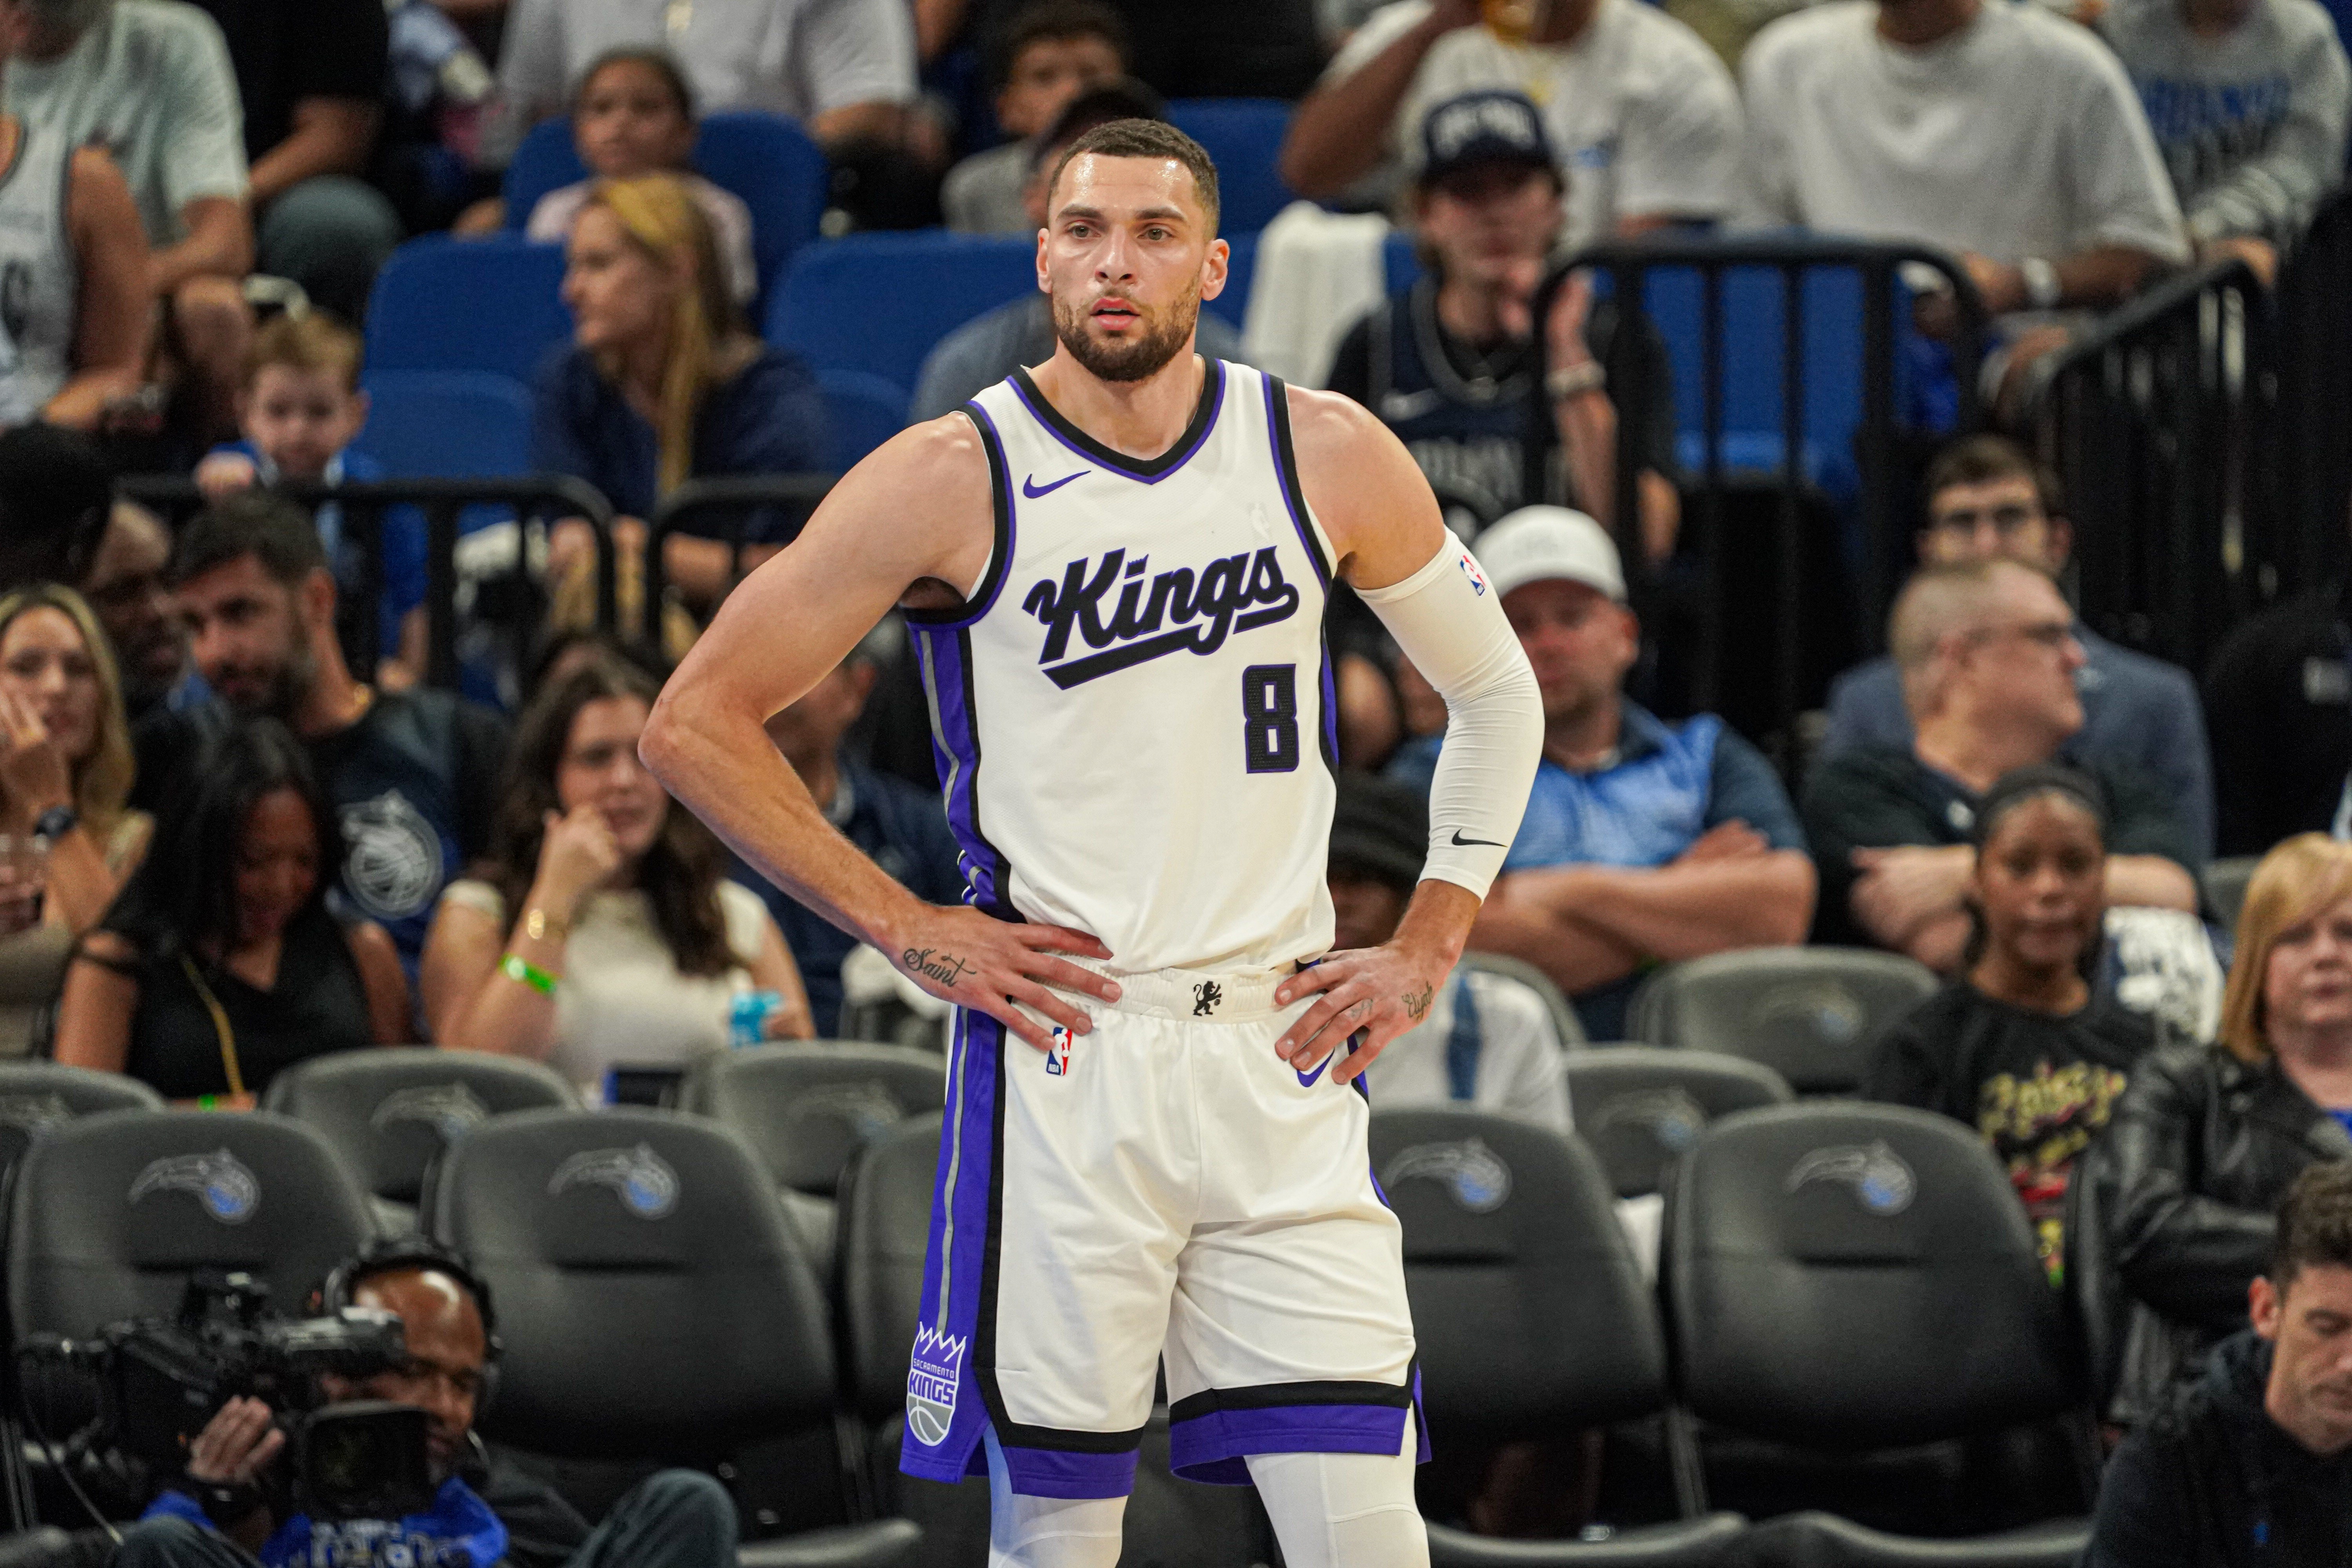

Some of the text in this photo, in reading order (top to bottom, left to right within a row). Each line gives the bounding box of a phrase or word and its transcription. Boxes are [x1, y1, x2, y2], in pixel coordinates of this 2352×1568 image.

[1022, 545, 1299, 690] Kings
[1242, 663, 1299, 774] 8
[903, 948, 977, 987] Saint
[1048, 1063, 1059, 1073] NBA
[913, 1358, 955, 1379] SACRAMENTO
[909, 1371, 956, 1406] KINGS
